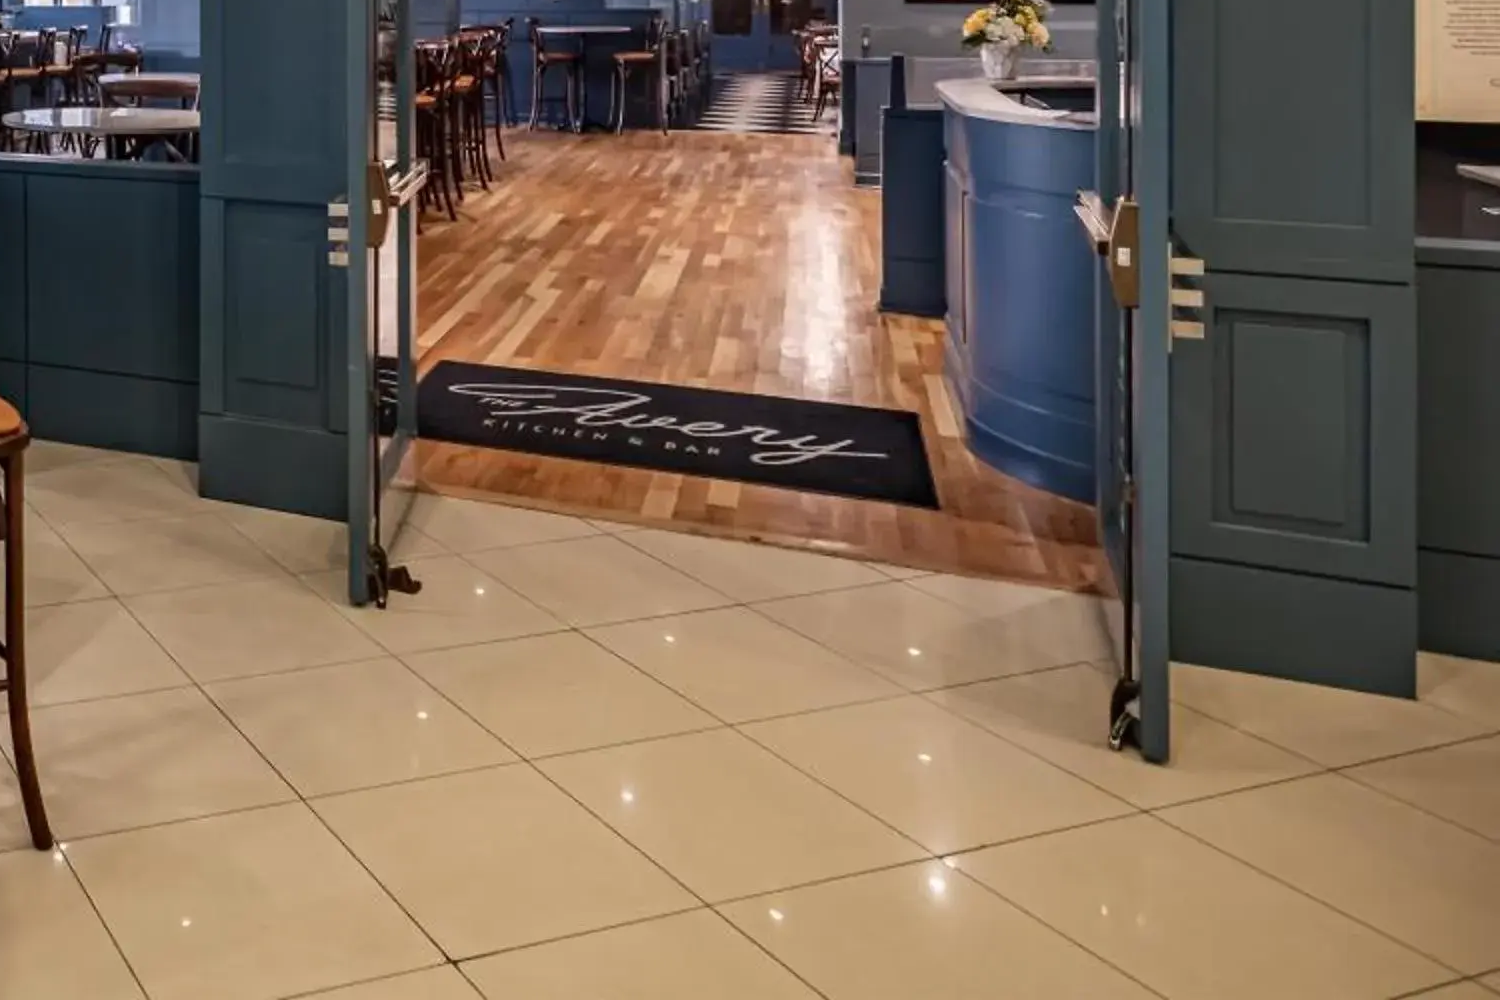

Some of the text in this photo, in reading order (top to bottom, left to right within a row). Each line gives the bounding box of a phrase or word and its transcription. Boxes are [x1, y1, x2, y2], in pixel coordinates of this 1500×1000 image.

[479, 396, 528, 408] THE
[448, 383, 890, 466] Avery
[482, 418, 721, 456] KITCHEN & BAR
